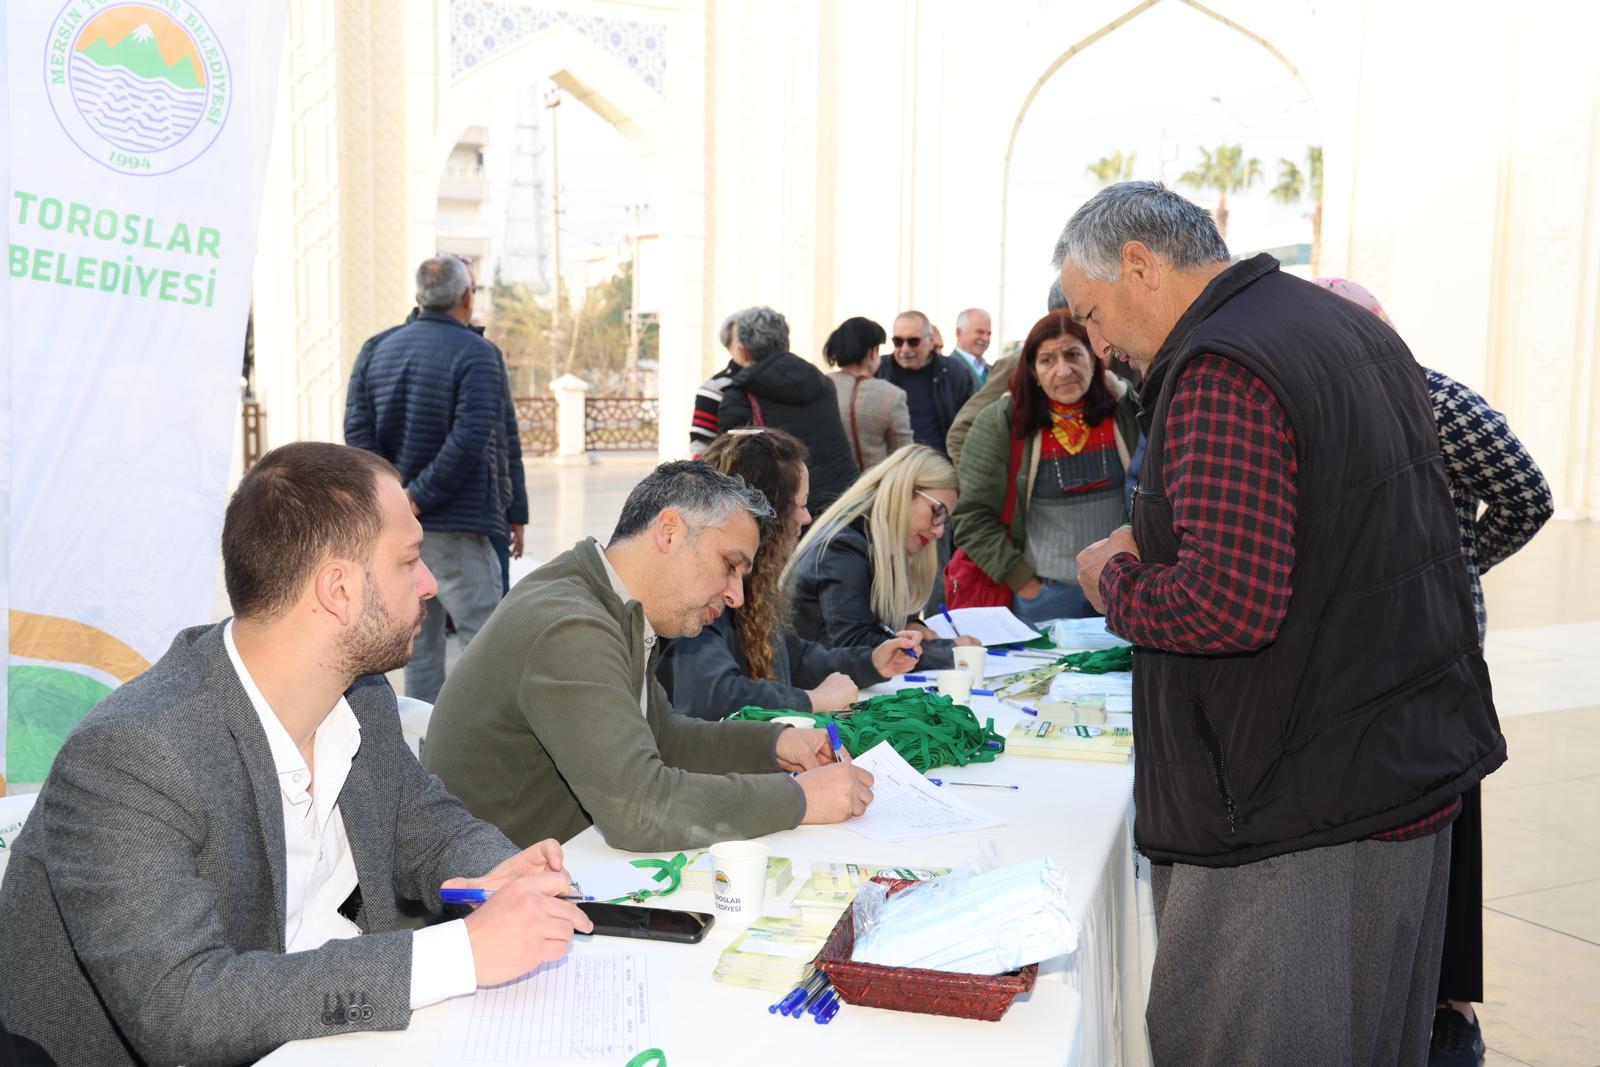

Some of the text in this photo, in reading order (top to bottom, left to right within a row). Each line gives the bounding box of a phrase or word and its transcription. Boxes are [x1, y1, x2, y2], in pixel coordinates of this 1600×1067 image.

[51, 8, 227, 126] MERSİN BELEDİYESİ
[108, 150, 152, 169] 1994
[14, 190, 221, 259] TOROSLAR
[8, 243, 217, 308] BELEDİYESİ
